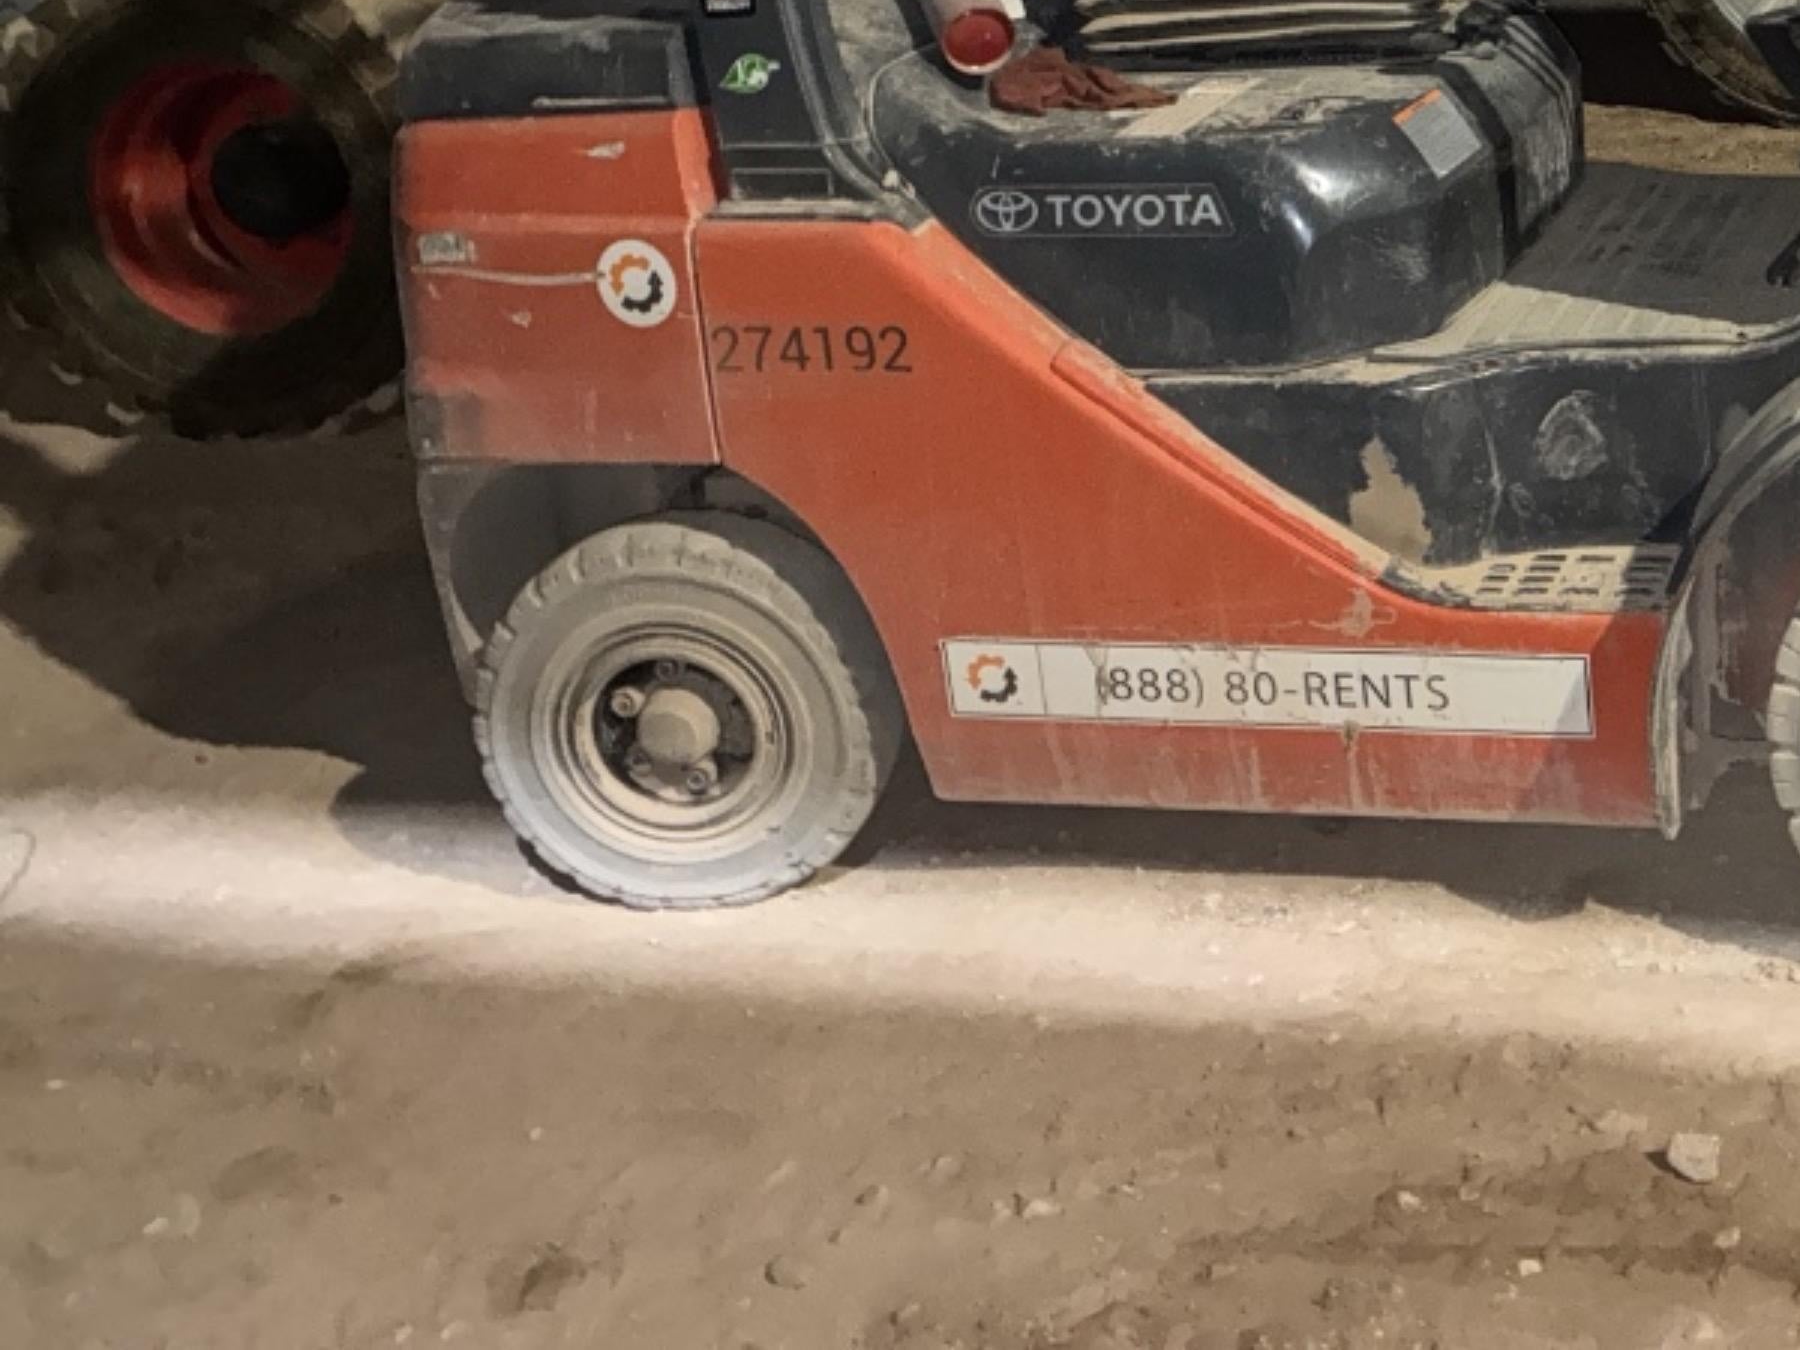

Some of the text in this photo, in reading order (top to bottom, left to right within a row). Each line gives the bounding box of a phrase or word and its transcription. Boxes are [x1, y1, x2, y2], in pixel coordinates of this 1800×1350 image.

[1046, 193, 1222, 228] TOYOTA
[711, 326, 913, 372] 274192
[1097, 668, 1451, 712] (888) 80-RENTS
